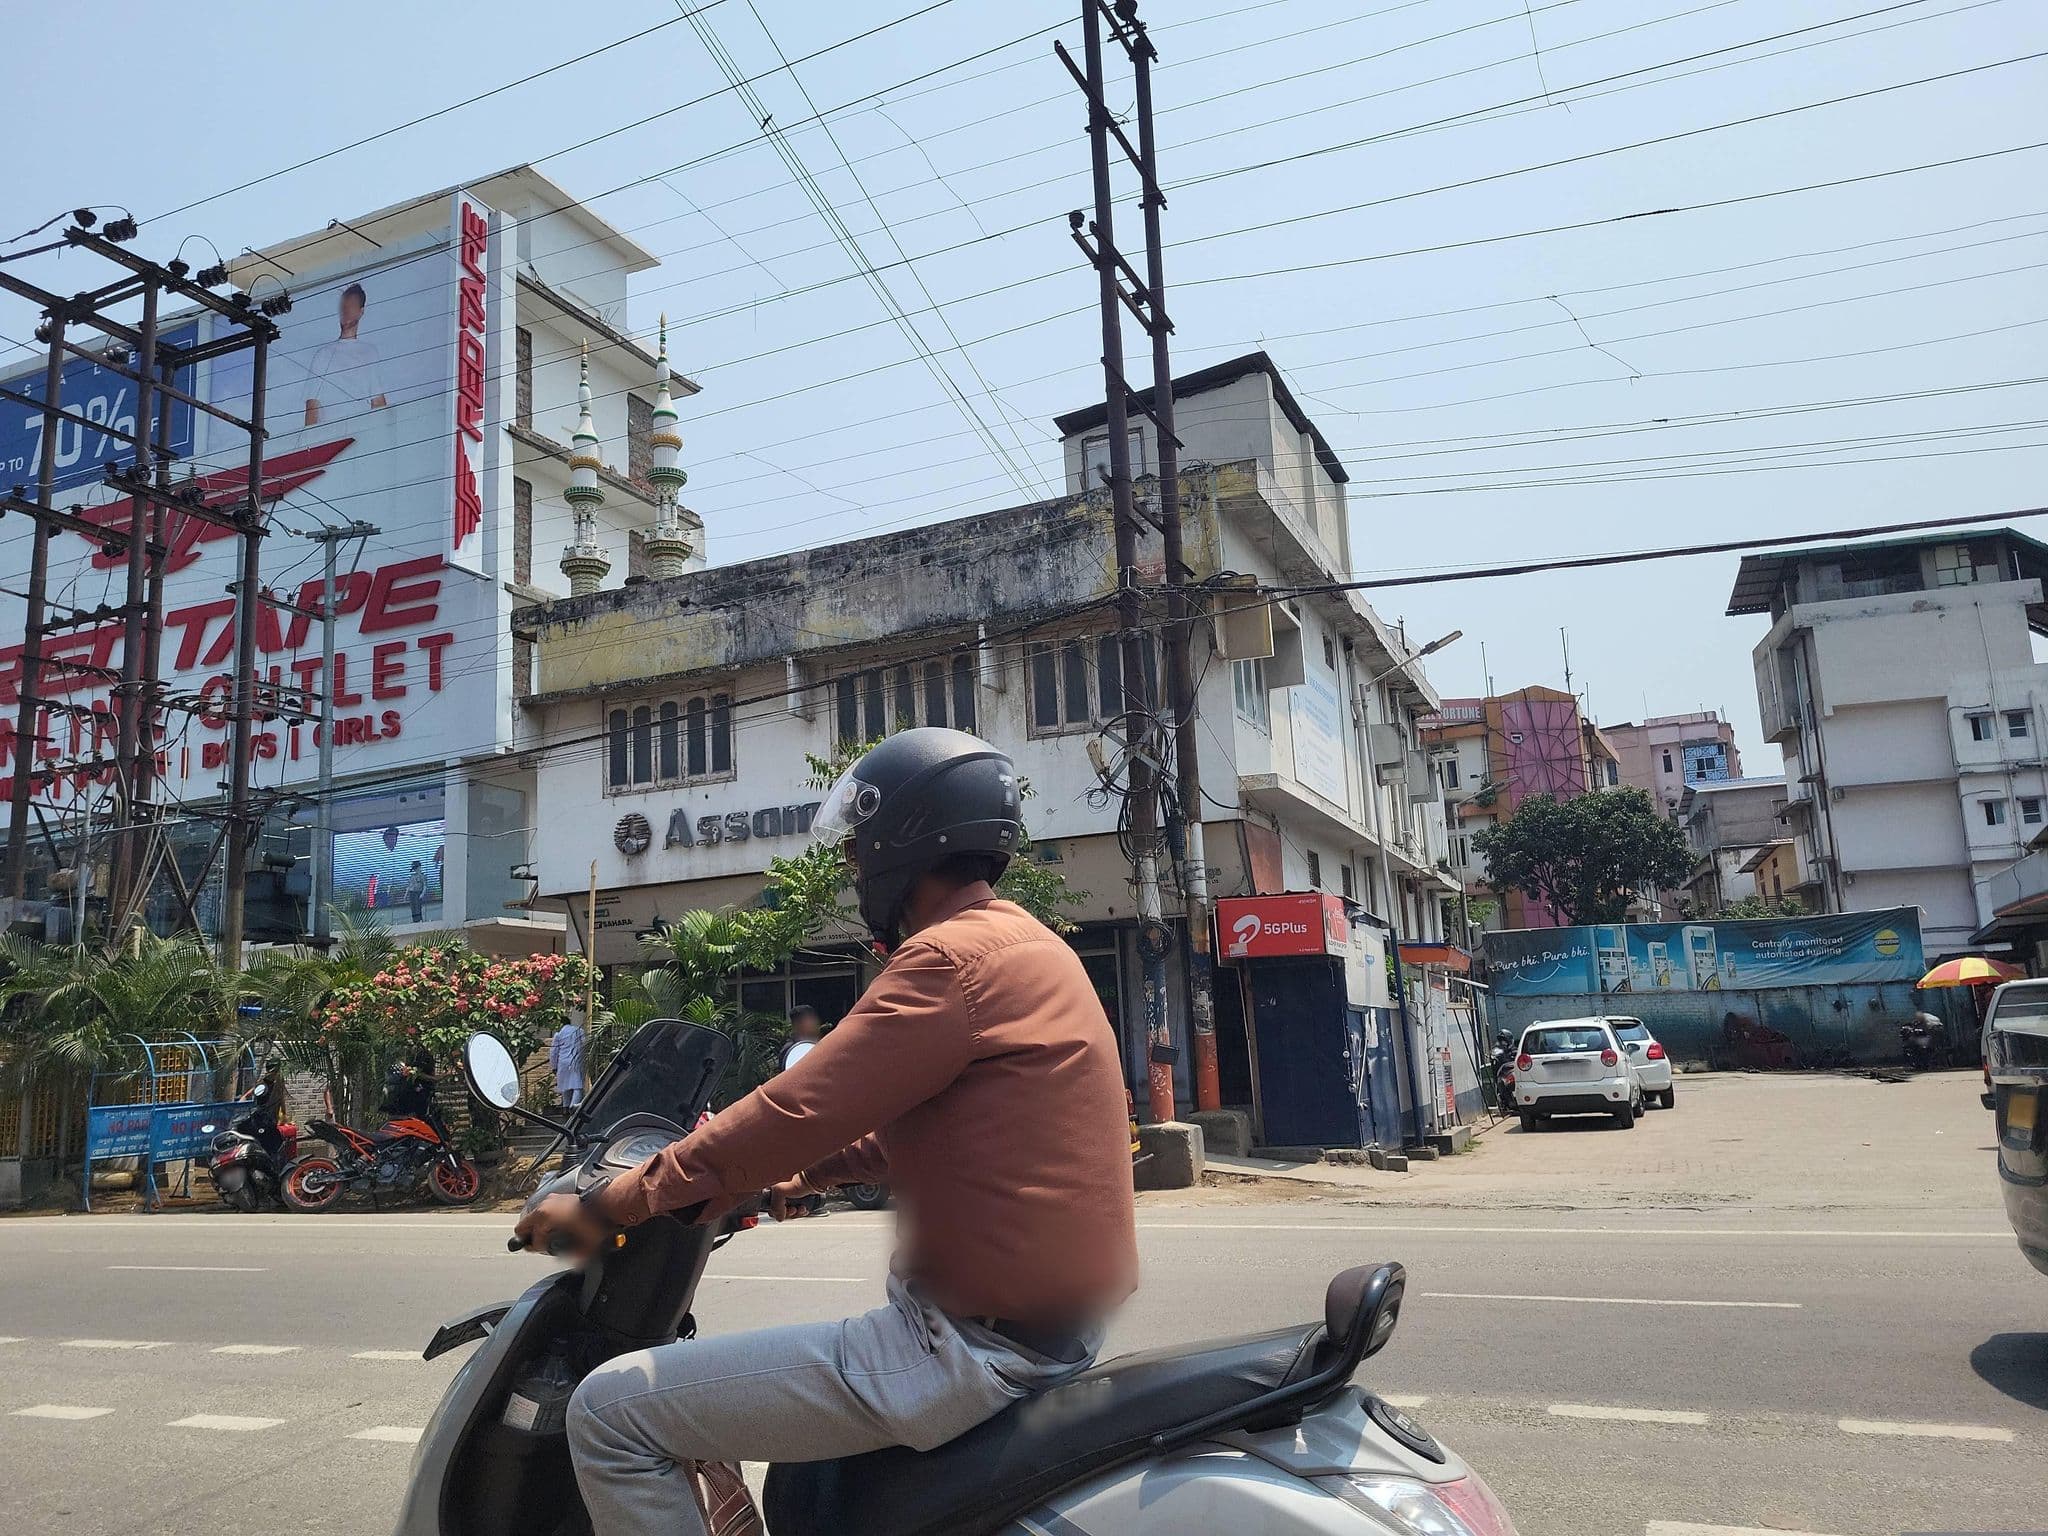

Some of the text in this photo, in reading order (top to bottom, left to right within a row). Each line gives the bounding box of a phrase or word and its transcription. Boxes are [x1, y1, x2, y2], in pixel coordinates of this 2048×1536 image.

[25, 388, 136, 477] 70%
[8, 456, 24, 473] TO
[199, 632, 453, 730] OUTLET
[313, 710, 401, 748] GIRLS
[1542, 951, 1569, 963] Pura
